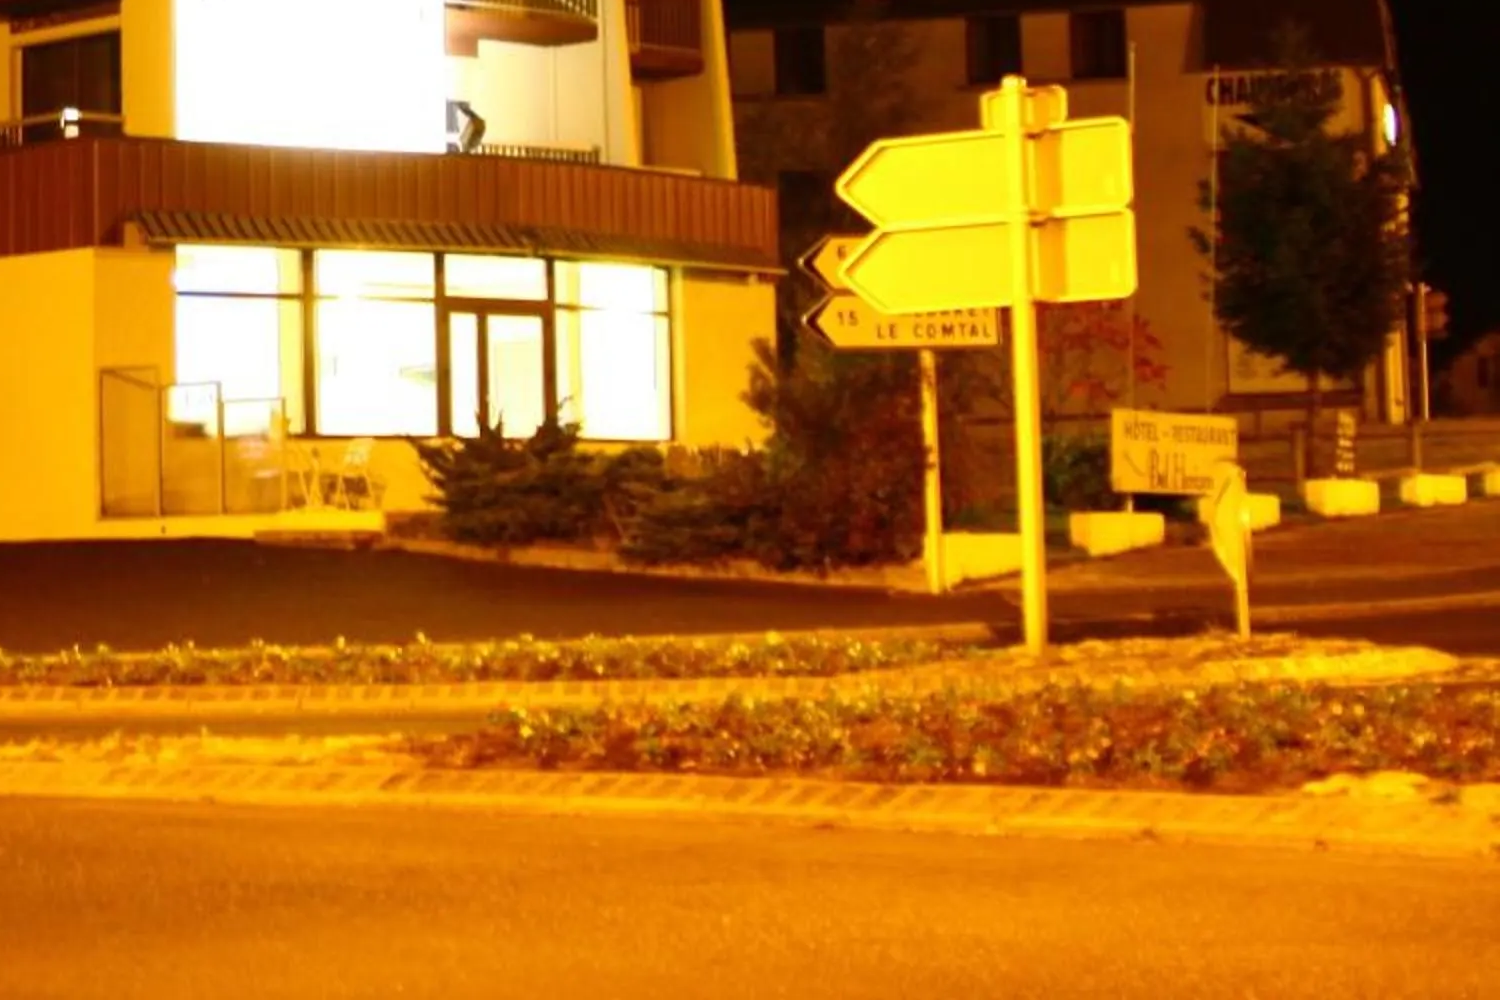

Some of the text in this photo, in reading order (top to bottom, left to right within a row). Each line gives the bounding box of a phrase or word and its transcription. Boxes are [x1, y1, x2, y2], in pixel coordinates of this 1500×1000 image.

[837, 310, 859, 327] 15
[876, 322, 992, 340] LE COMTAL
